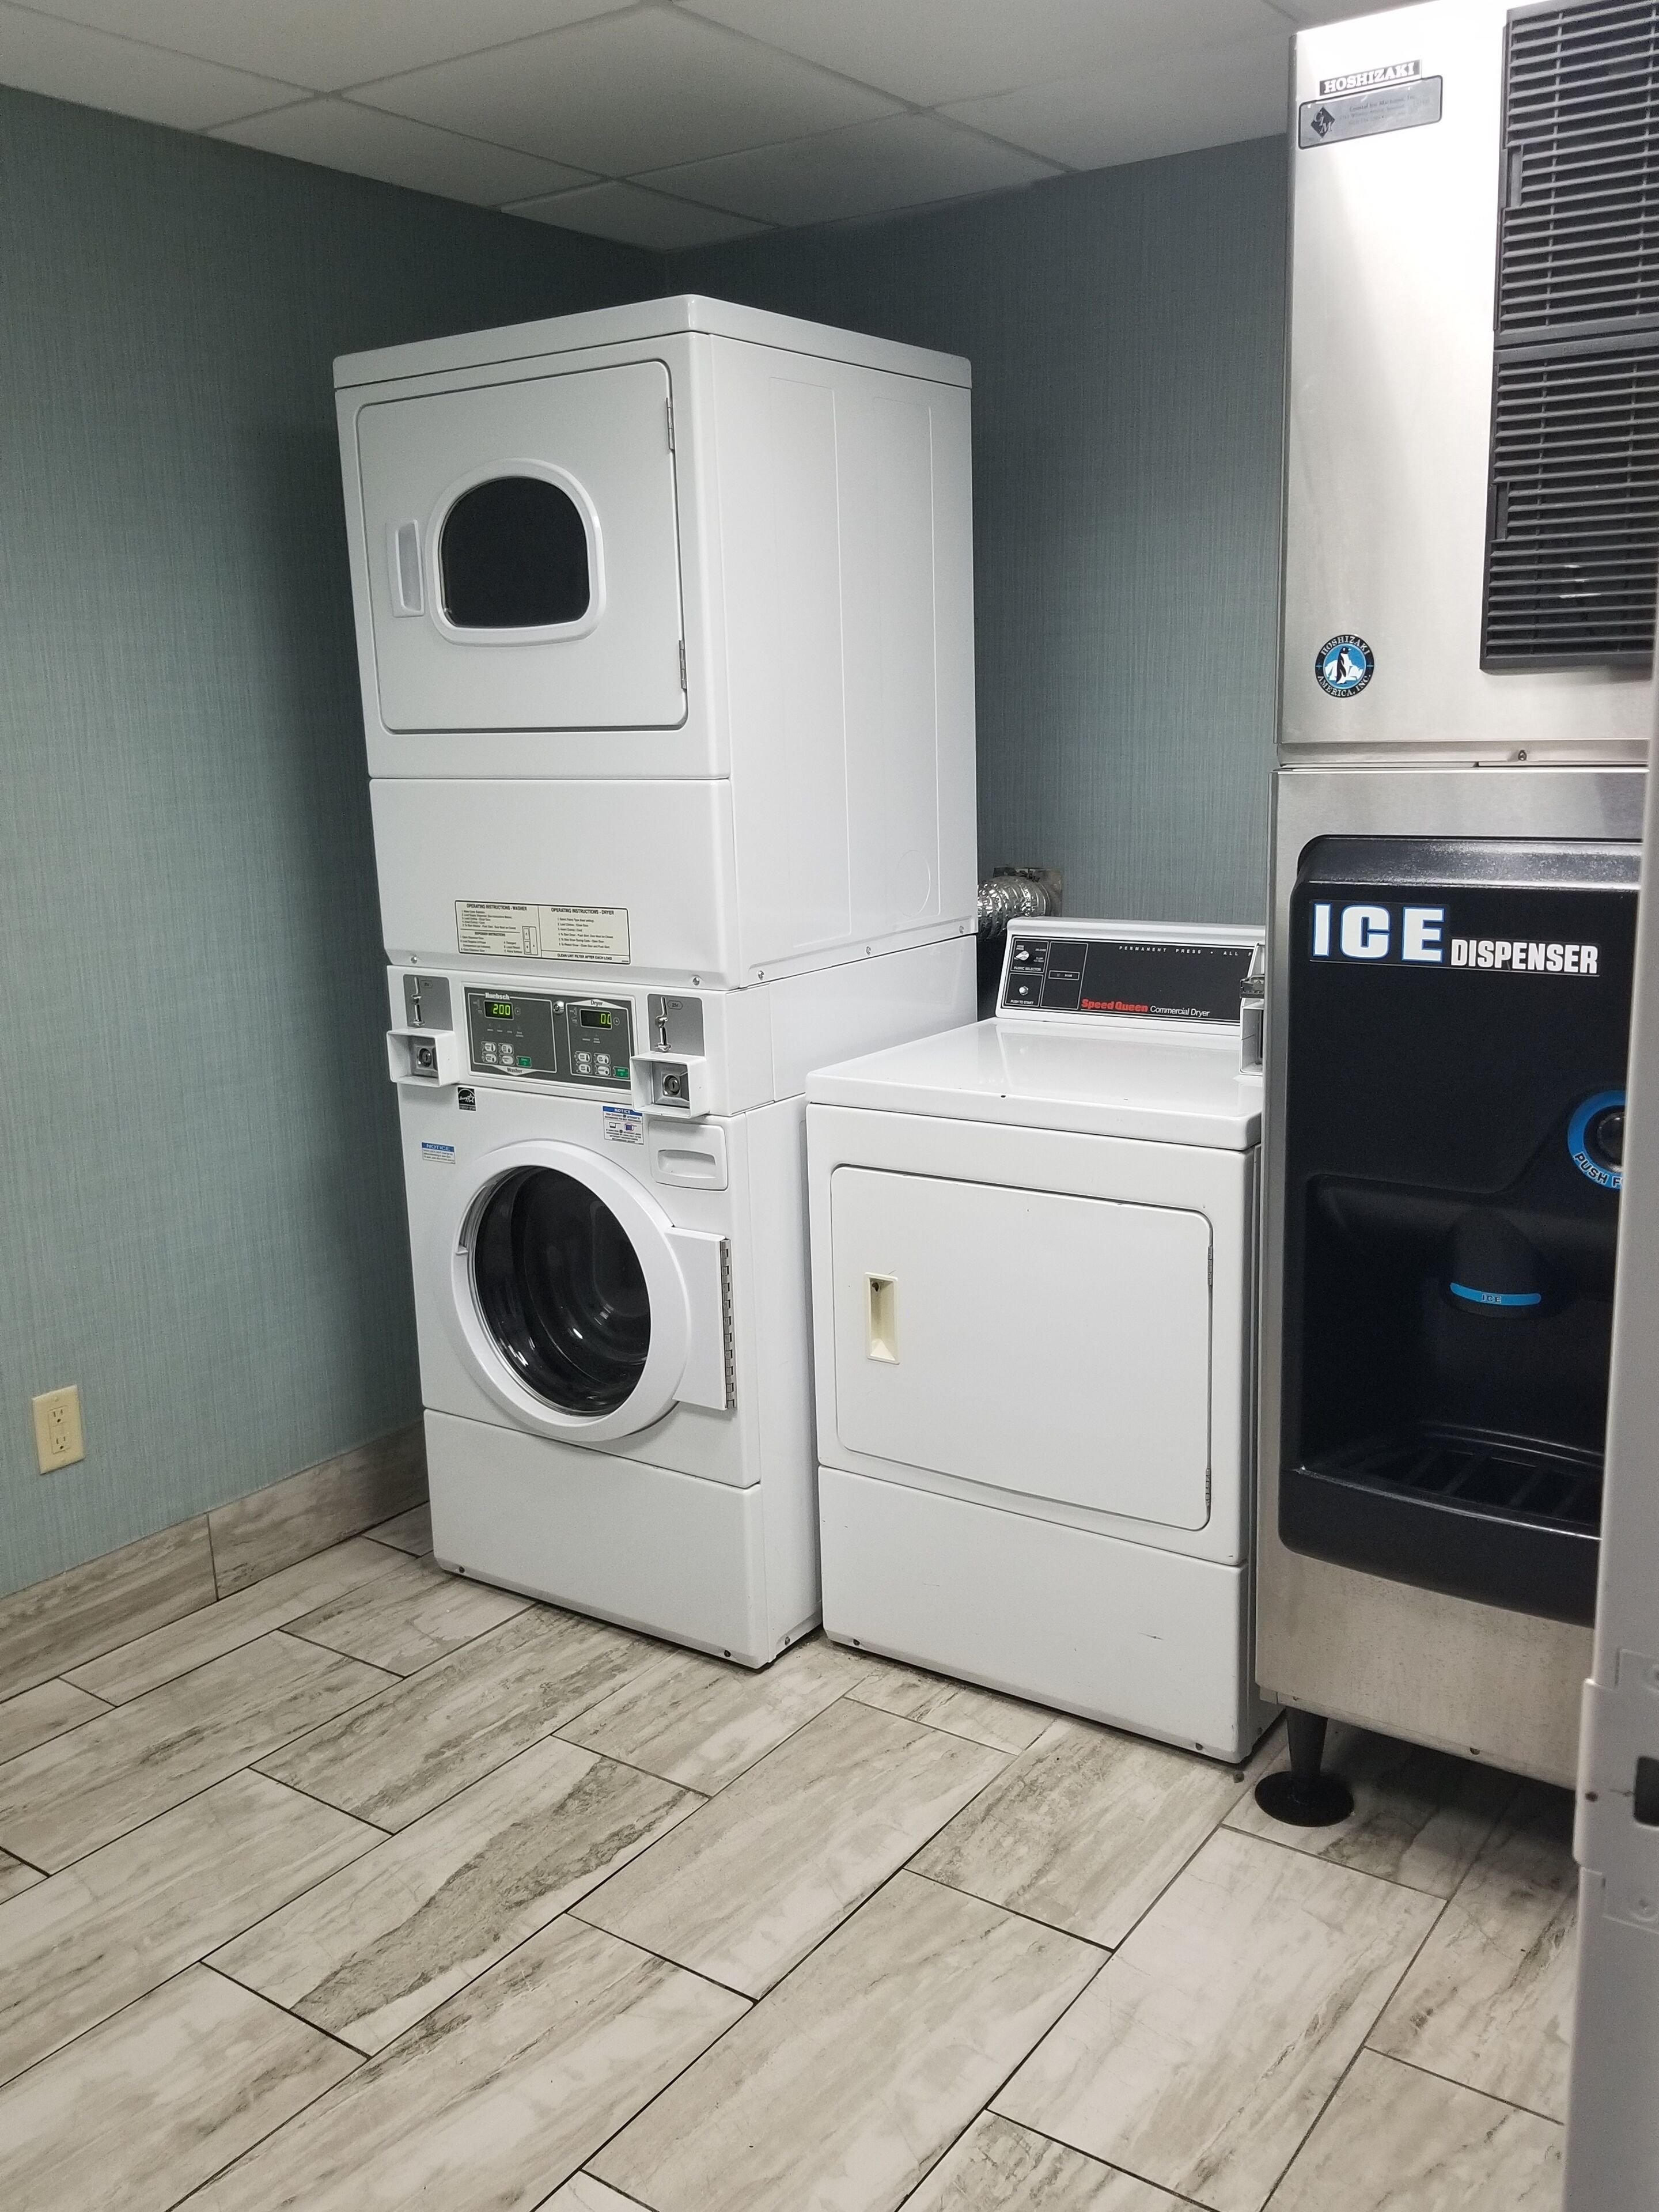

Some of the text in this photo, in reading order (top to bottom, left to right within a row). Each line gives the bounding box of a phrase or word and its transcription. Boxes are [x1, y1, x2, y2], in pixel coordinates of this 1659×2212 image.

[1324, 62, 1415, 93] HOSHIZAKI
[1321, 635, 1370, 656] HOSHIZAKI
[1317, 674, 1371, 696] AMERICA, INC.
[1313, 903, 1599, 974] ICE DISPENSER
[493, 1003, 511, 1016] 200
[1150, 1005, 1190, 1016] Commercial
[1190, 1008, 1210, 1017] Dryer
[1573, 1152, 1608, 1184] PUSH
[1482, 1294, 1502, 1303] ICE
